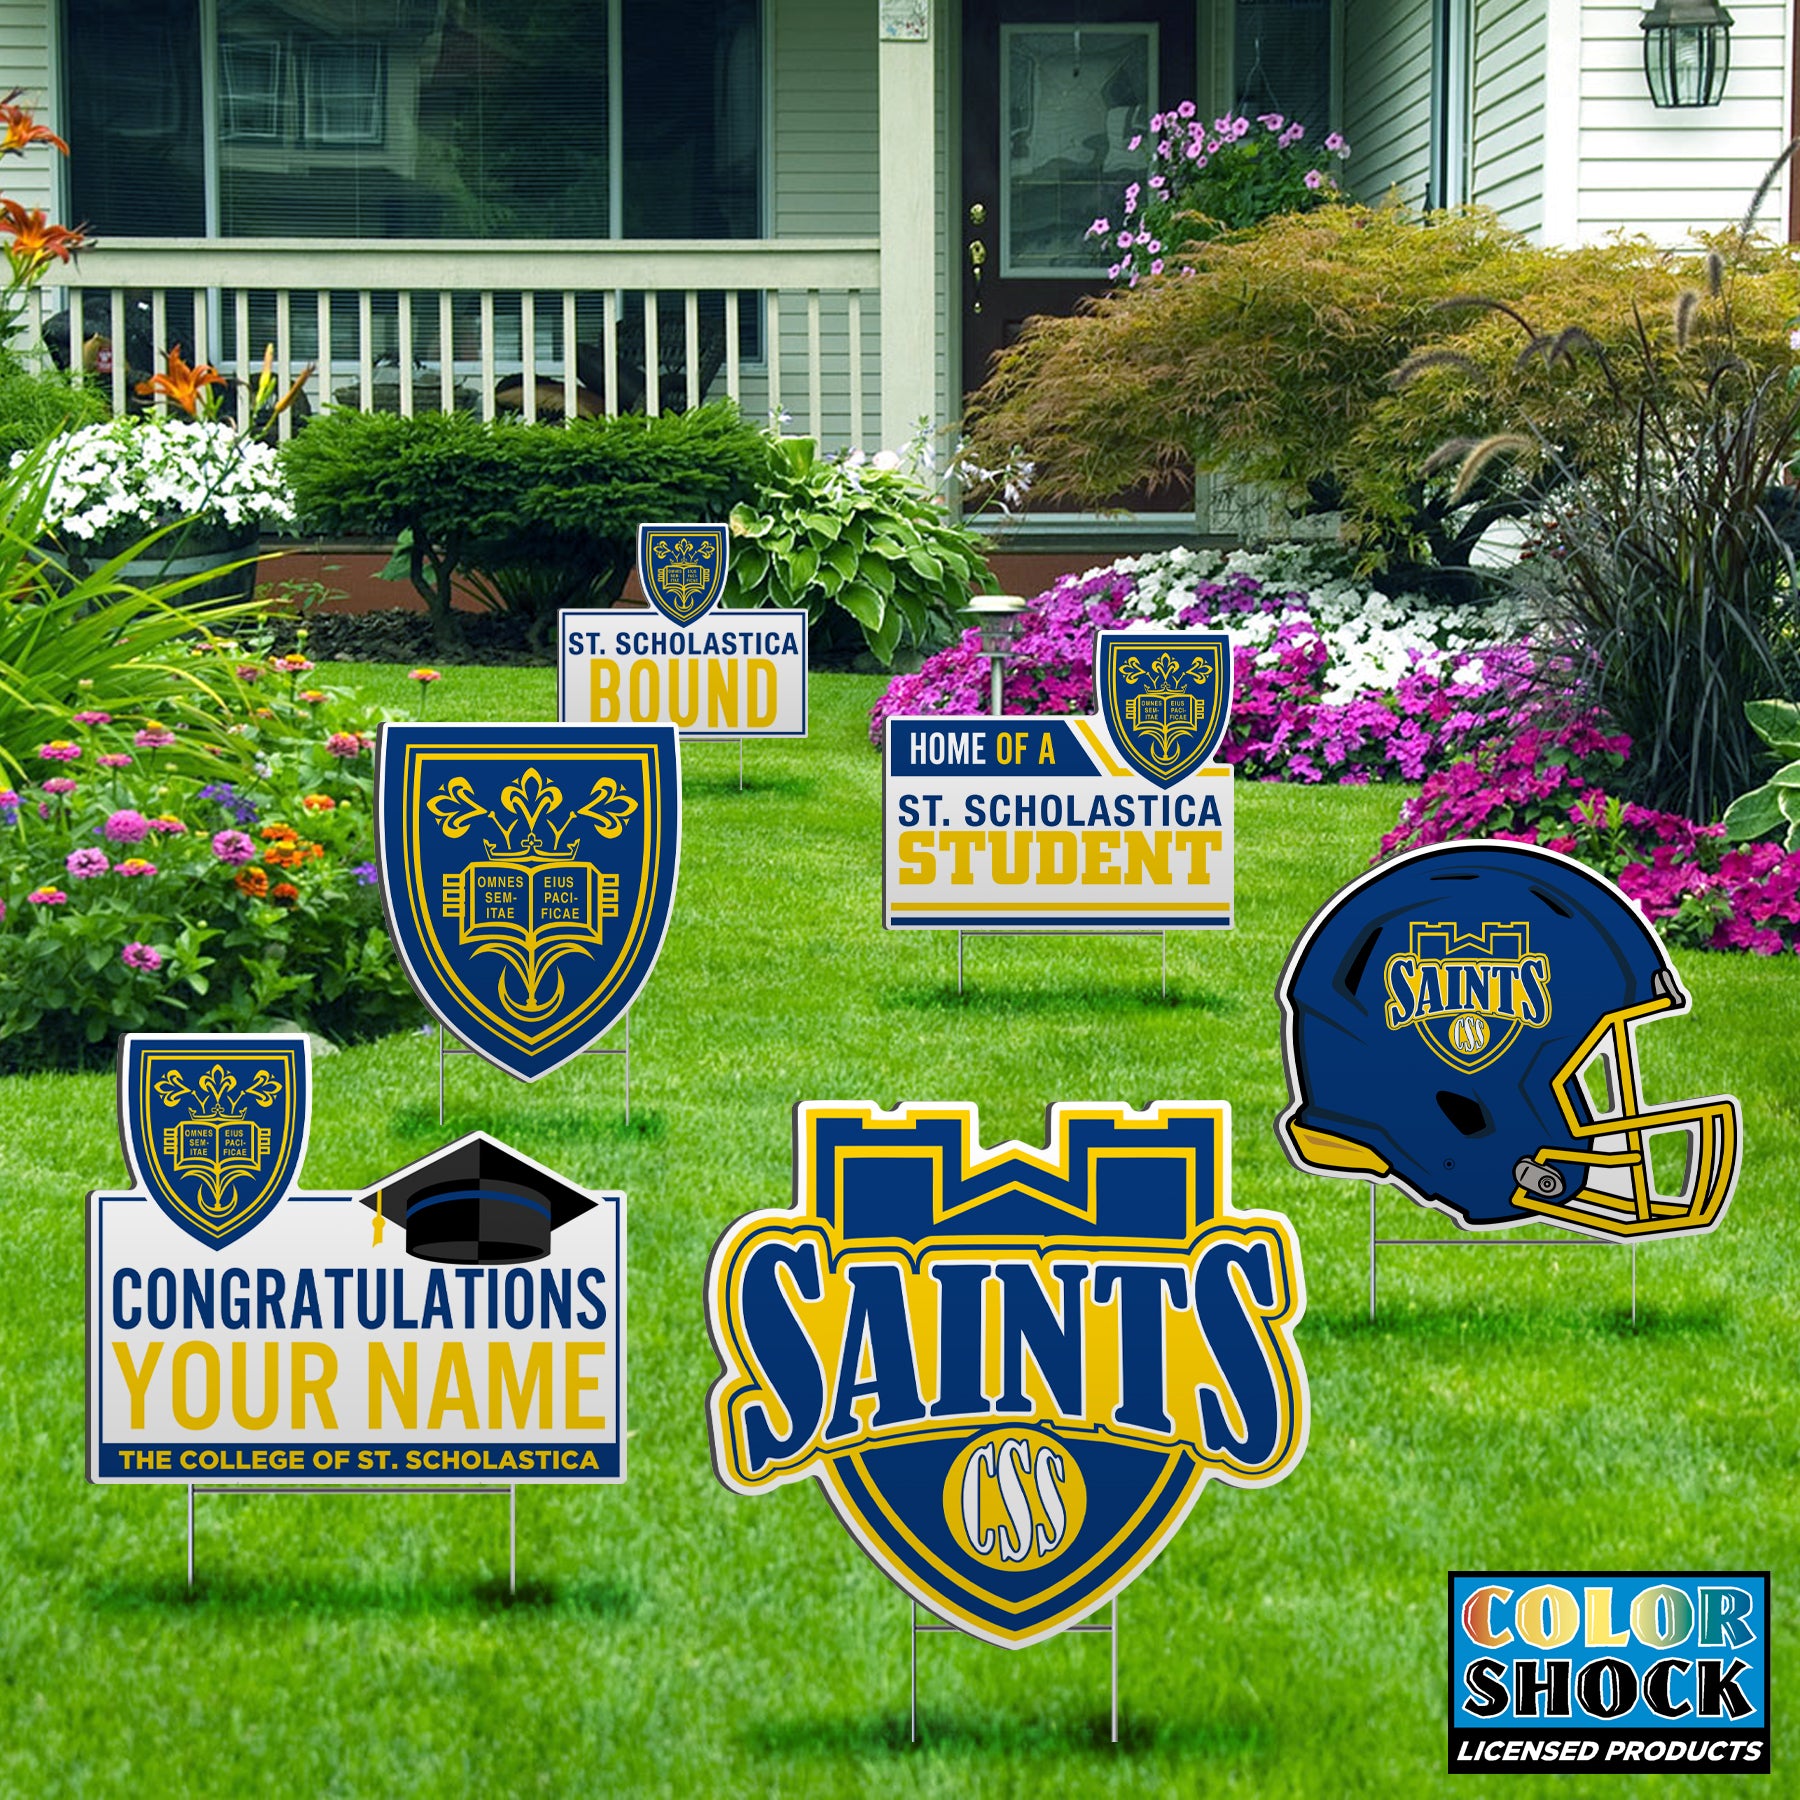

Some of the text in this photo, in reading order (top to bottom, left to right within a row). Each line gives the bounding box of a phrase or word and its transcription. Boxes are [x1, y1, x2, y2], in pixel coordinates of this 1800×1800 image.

[568, 632, 799, 655] ST. SCHOLASTICA
[590, 658, 778, 728] BOUND
[910, 732, 1056, 765] HOME OF A
[898, 794, 1222, 827] ST. SCHOLASTICA
[898, 831, 1223, 885] STUDENT
[477, 876, 524, 888] OMNES
[543, 876, 575, 888] EIUS
[485, 891, 518, 904] SEM-
[544, 891, 579, 904] PACI-
[486, 907, 515, 919] ITAE
[541, 907, 580, 919] FICAE
[1390, 958, 1546, 1027] SAINTS
[1453, 1016, 1485, 1052] CSS
[184, 1129, 213, 1137] OMNES
[224, 1129, 244, 1137] EIUS
[189, 1148, 208, 1156] ITAE
[223, 1148, 247, 1156] FICAE
[112, 1267, 607, 1330] CONGRATULATIONS
[741, 1240, 1279, 1473] SAINTS
[112, 1340, 606, 1431] YOUR NAME
[119, 1449, 600, 1471] THE COLLEGE OF ST. SCHOLASTICA
[961, 1438, 1067, 1562] CSS
